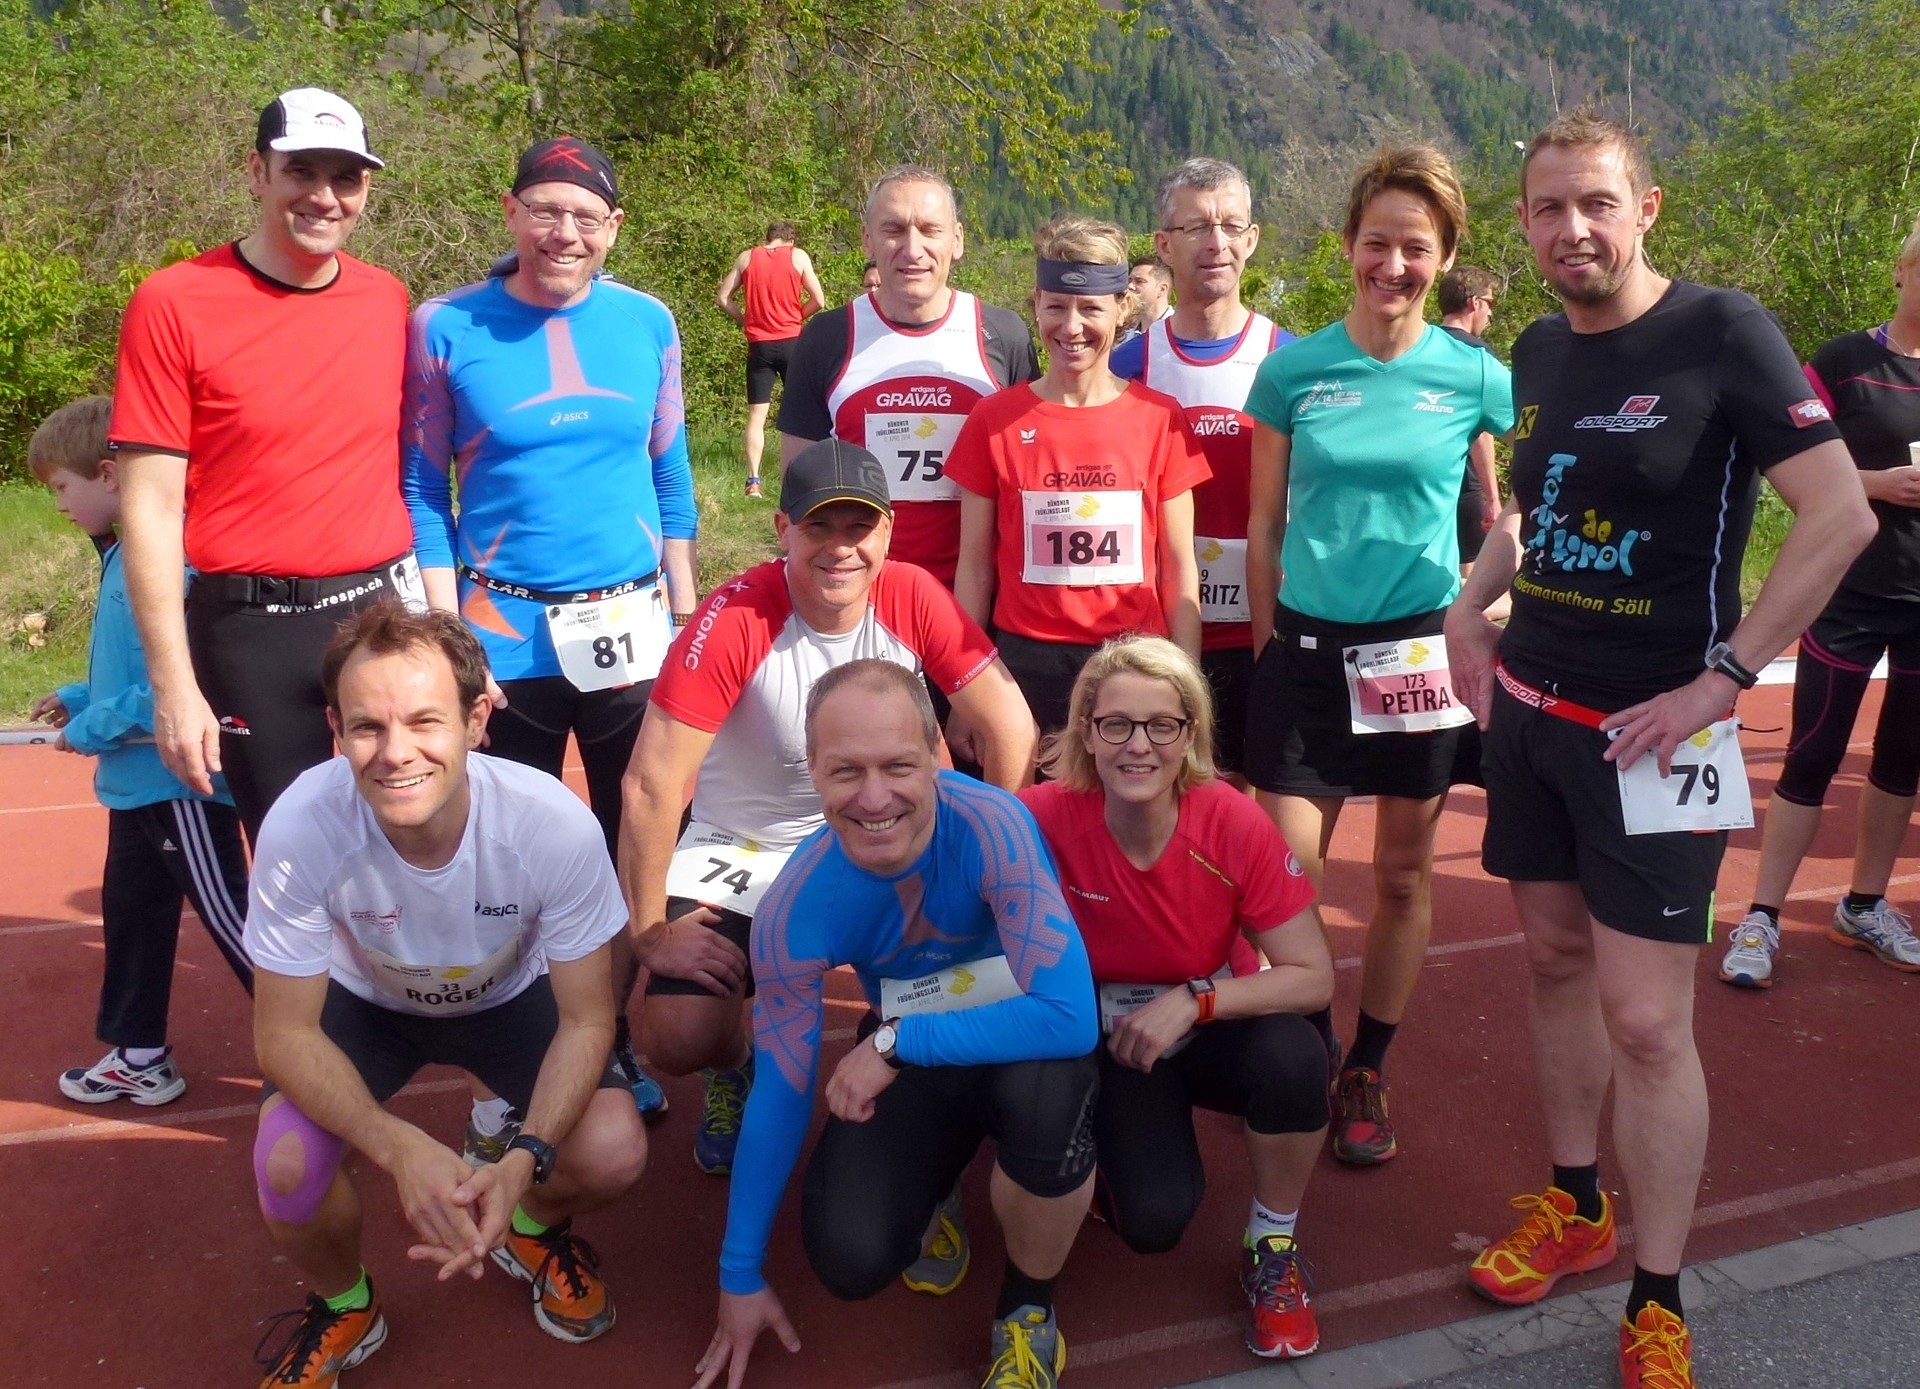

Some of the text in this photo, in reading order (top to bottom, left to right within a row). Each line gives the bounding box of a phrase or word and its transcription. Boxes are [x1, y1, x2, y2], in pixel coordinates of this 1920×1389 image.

[876, 393, 952, 407] GRAVAG
[562, 410, 589, 421] asics
[1574, 415, 1668, 428] JOLSPORT
[1191, 421, 1240, 435] AVAG
[897, 450, 945, 482] 75
[1076, 464, 1101, 472] erdgas
[1043, 472, 1117, 488] GRAVAG
[1582, 509, 1612, 543] de
[1046, 530, 1121, 565] 184
[1200, 583, 1240, 605] RITZ
[1610, 597, 1652, 616] Söll
[685, 594, 728, 671] BIONIC
[592, 632, 636, 669] 81
[1402, 673, 1427, 690] 173
[1381, 686, 1452, 714] PETRA
[1670, 763, 1720, 806] 79
[698, 857, 753, 896] 74
[1069, 885, 1110, 902] MAMMUT
[481, 903, 519, 917] asics
[405, 976, 495, 1005] ROGER
[439, 983, 460, 993] 33
[912, 976, 939, 990] BÜNDNER
[897, 985, 941, 1004] FRÜHLINGSLAUF
